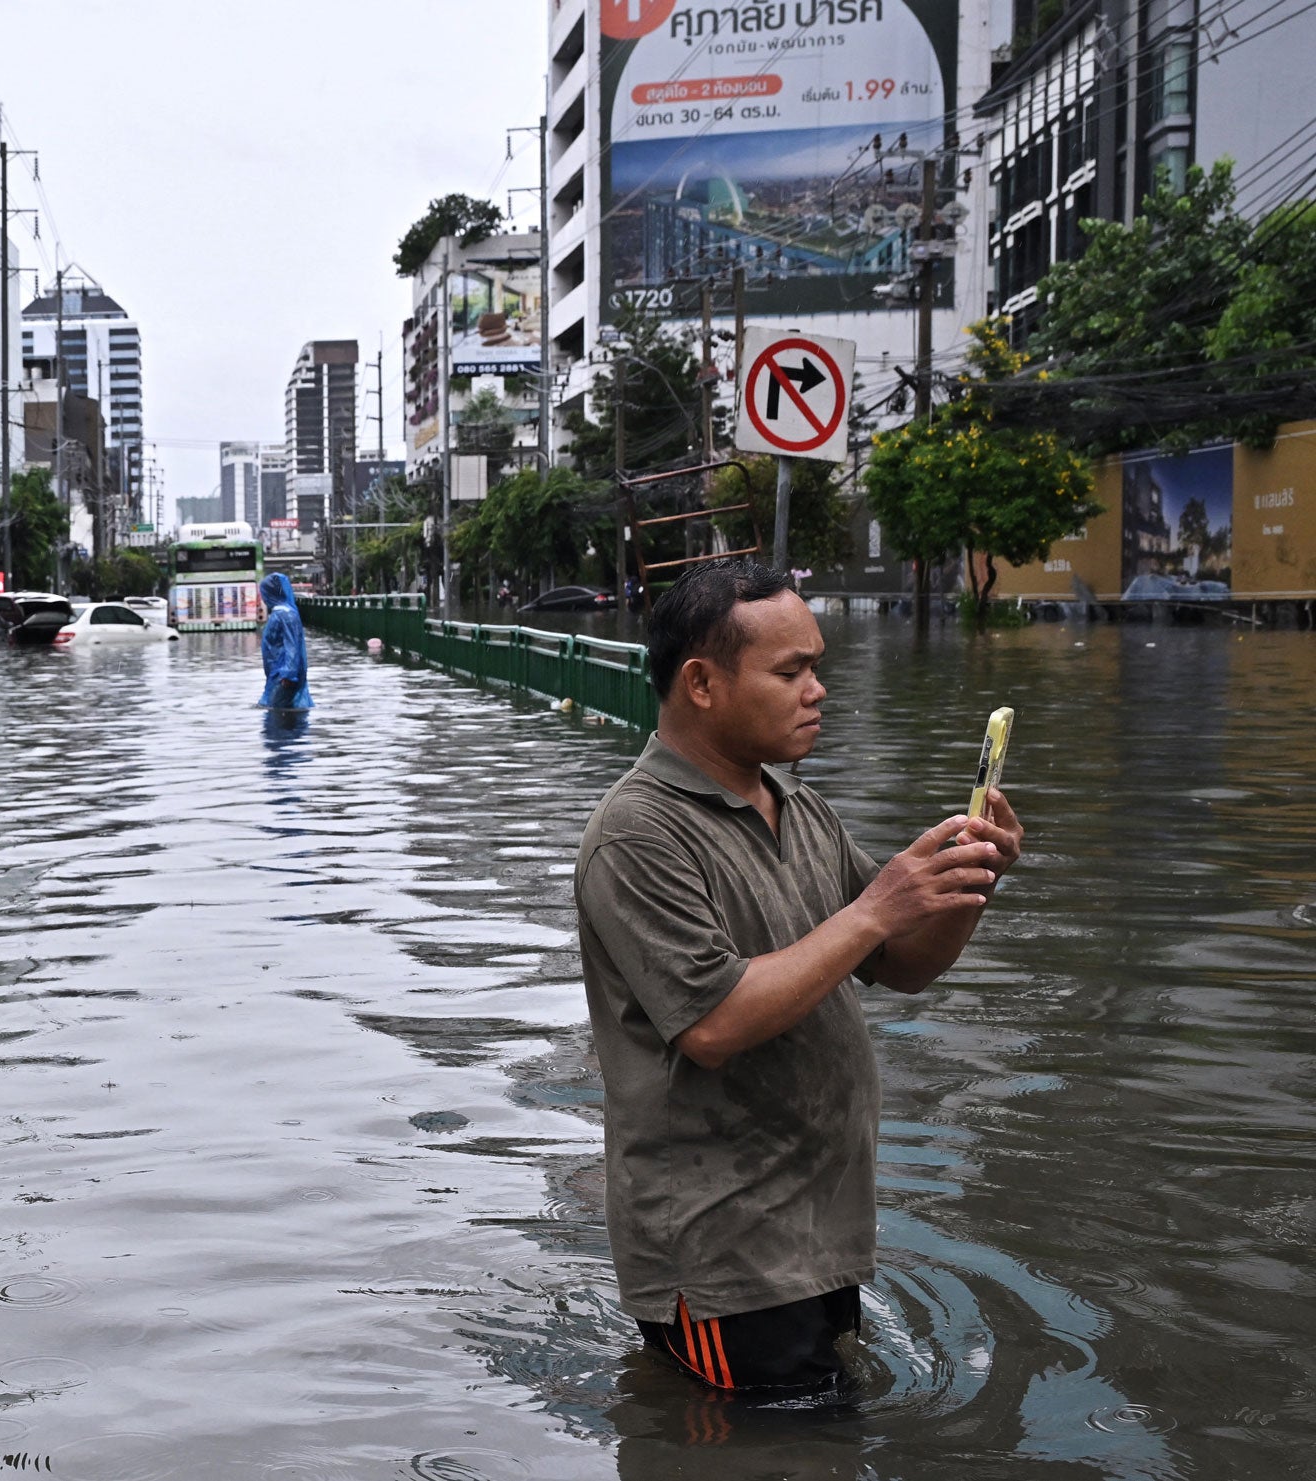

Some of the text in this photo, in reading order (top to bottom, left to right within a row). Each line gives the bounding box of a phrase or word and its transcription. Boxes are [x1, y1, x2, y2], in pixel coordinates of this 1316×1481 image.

[796, 0, 883, 27] ปารค
[845, 78, 895, 101] 1.99
[636, 111, 674, 126] ขนาด
[625, 288, 673, 309] 1720
